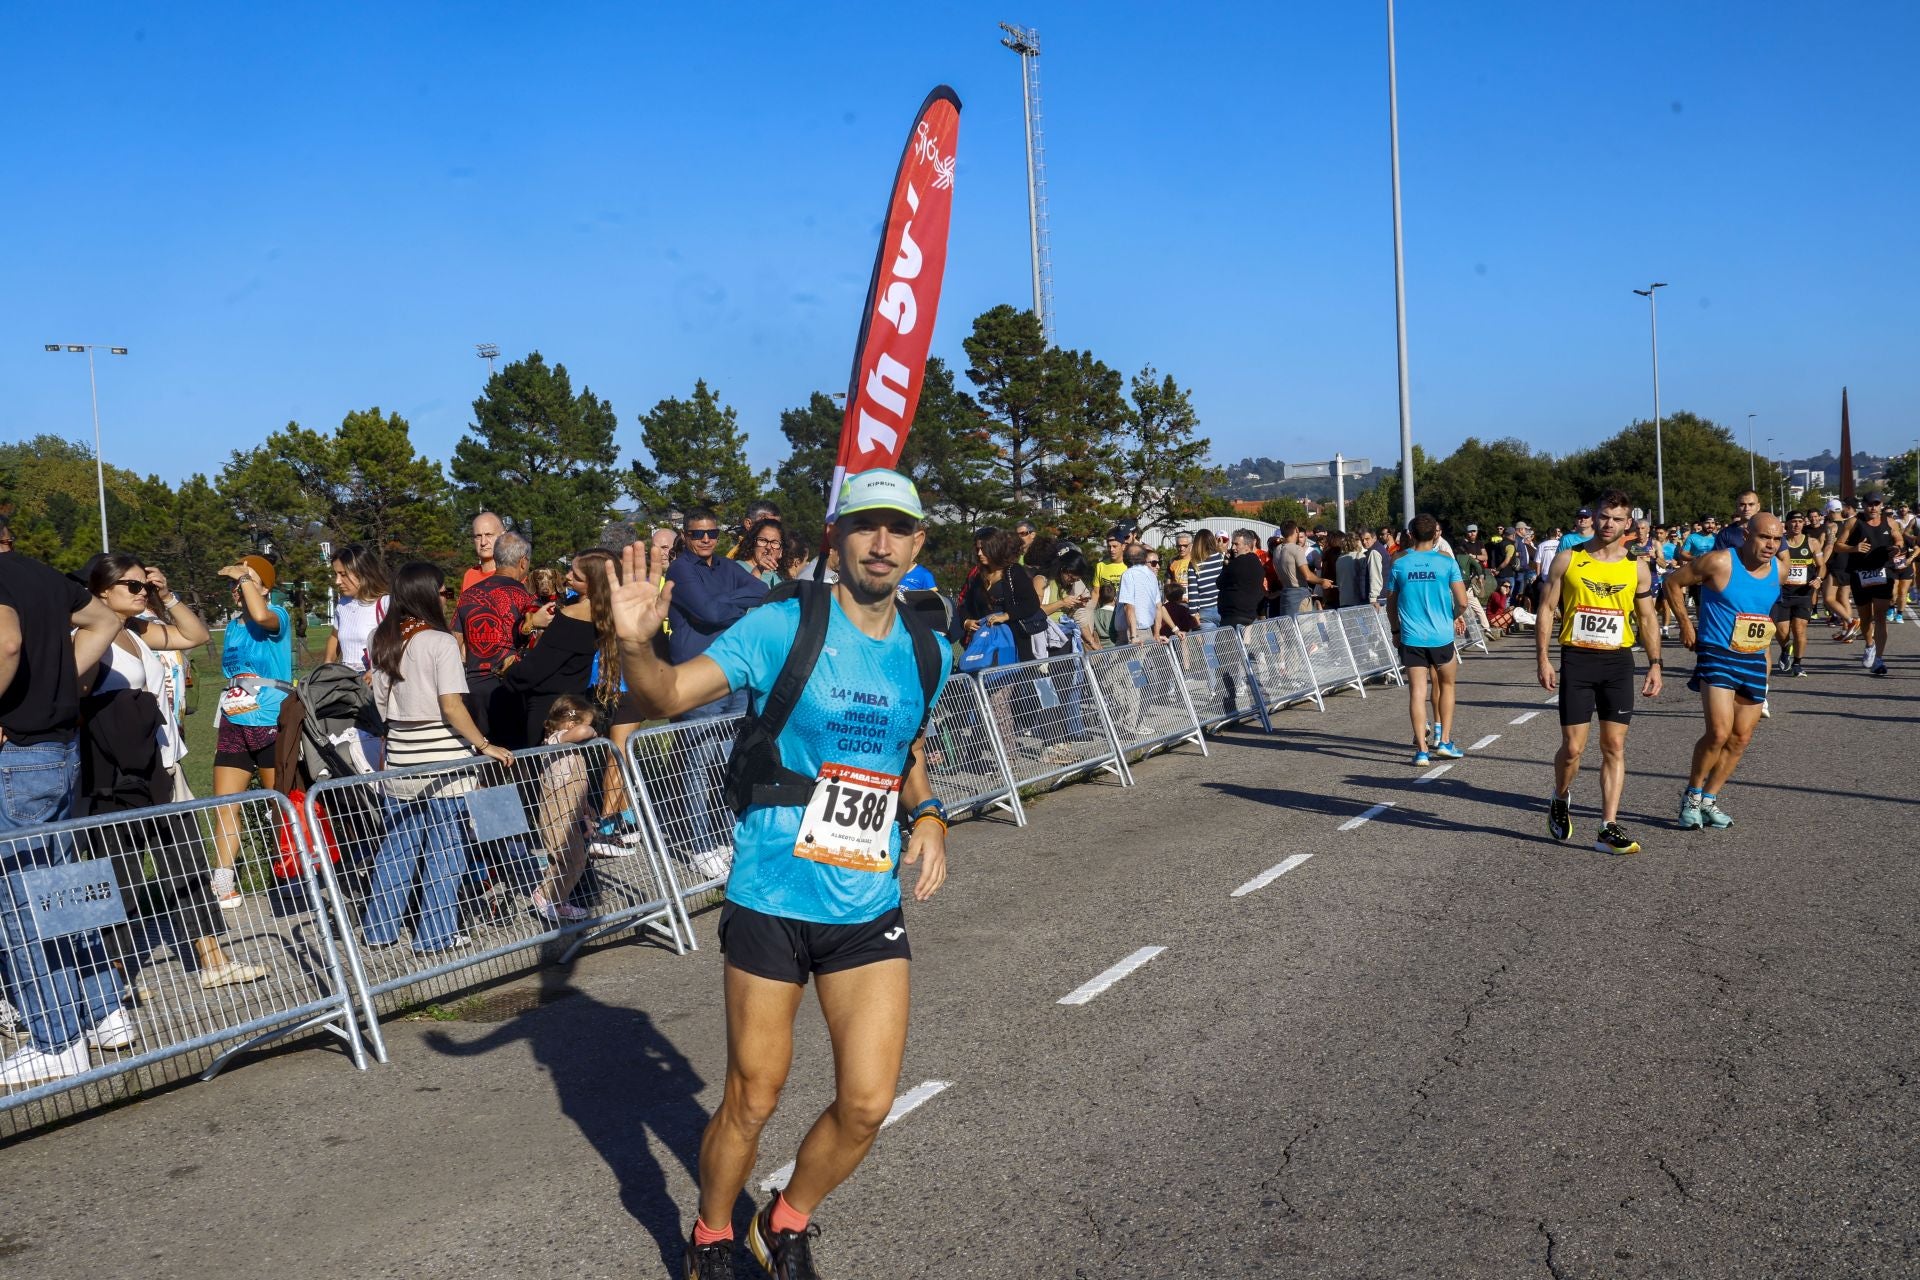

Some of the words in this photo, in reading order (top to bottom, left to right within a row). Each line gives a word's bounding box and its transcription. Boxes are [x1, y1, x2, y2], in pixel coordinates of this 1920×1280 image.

[858, 352, 911, 456] 1h
[1407, 571, 1436, 580] MBA
[1580, 614, 1618, 634] 1624
[1747, 622, 1766, 639] 66
[830, 687, 852, 703] 14ª
[852, 691, 889, 708] MBA
[844, 709, 889, 726] media
[826, 720, 887, 739] maratón
[837, 737, 883, 754] GIJÓN
[849, 771, 871, 783] MBA
[822, 784, 887, 832] 1388
